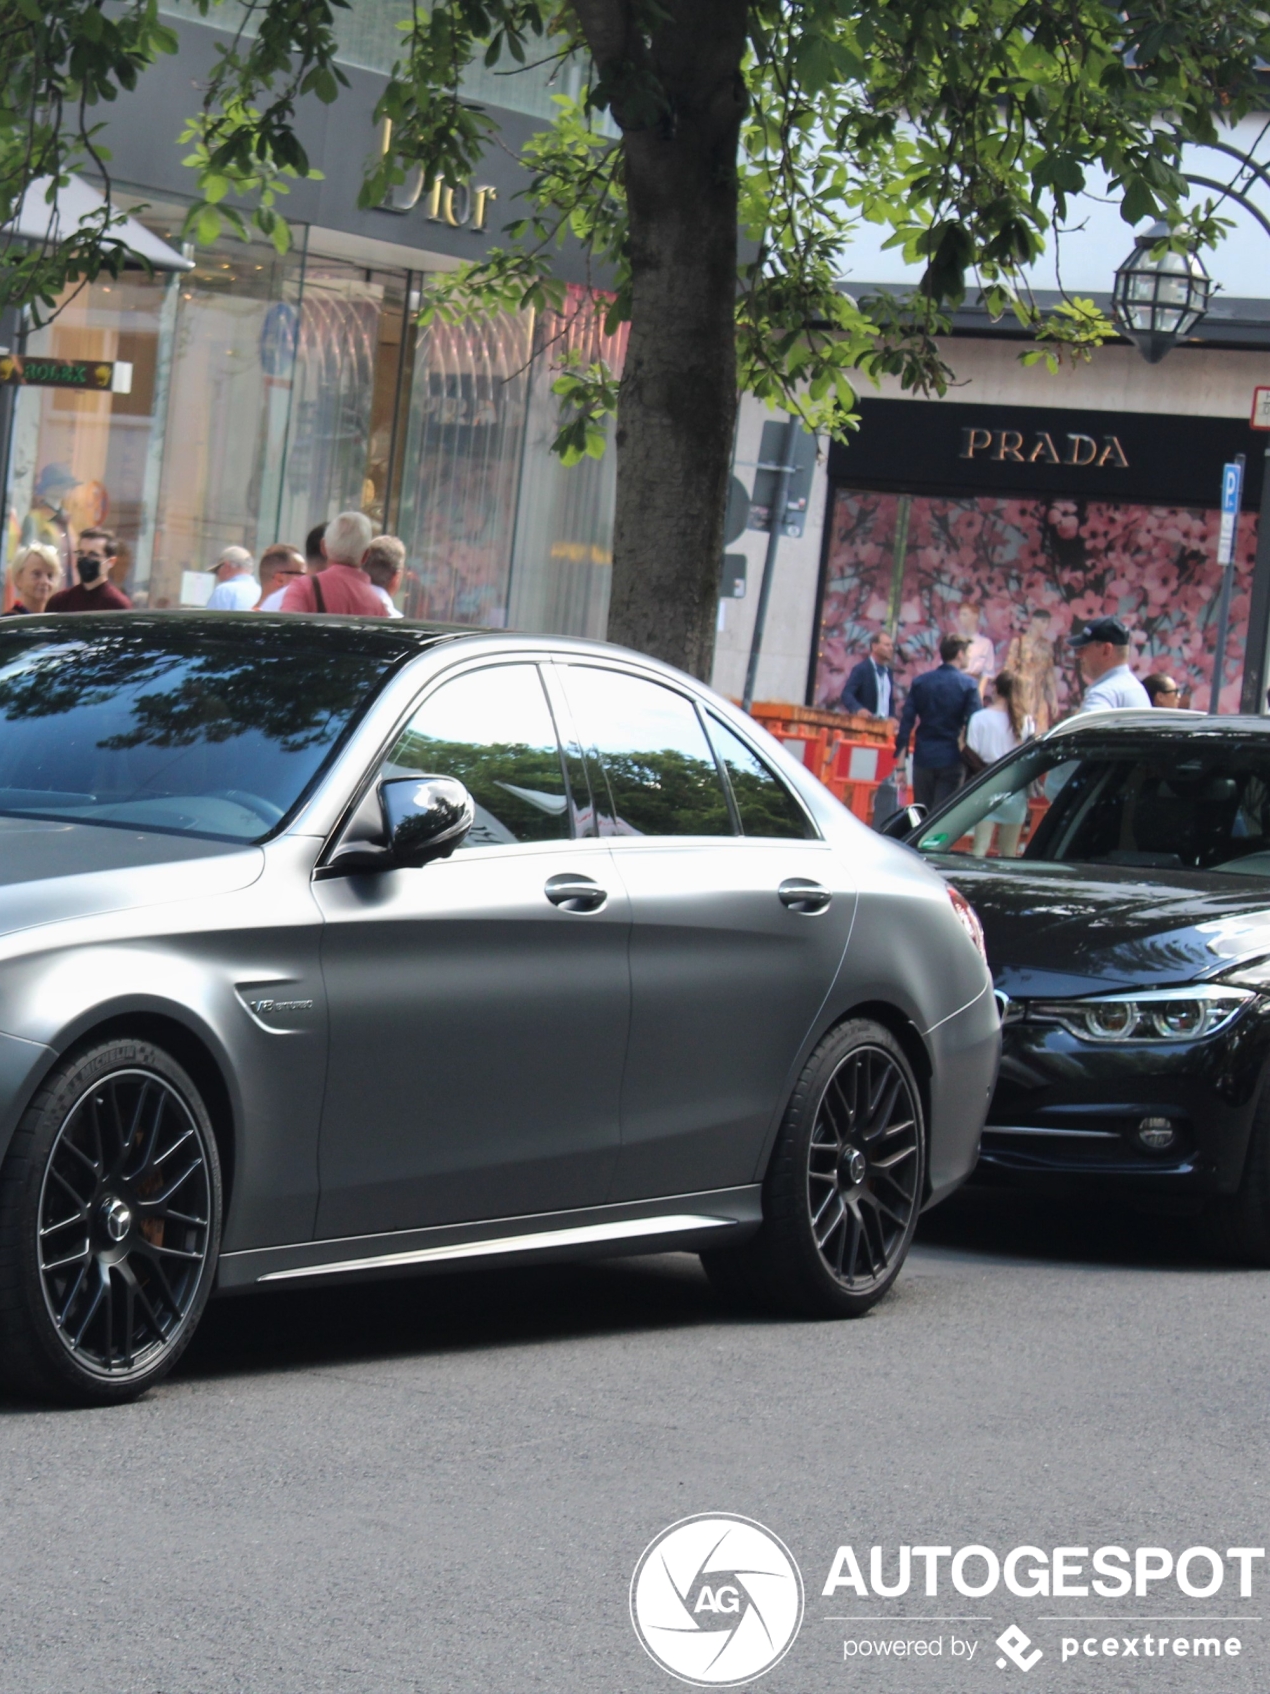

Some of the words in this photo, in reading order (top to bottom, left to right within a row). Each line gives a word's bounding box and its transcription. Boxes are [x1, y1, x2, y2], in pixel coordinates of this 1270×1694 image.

[24, 363, 87, 383] ROLEX
[959, 427, 1129, 468] PRADA
[1225, 471, 1236, 508] P
